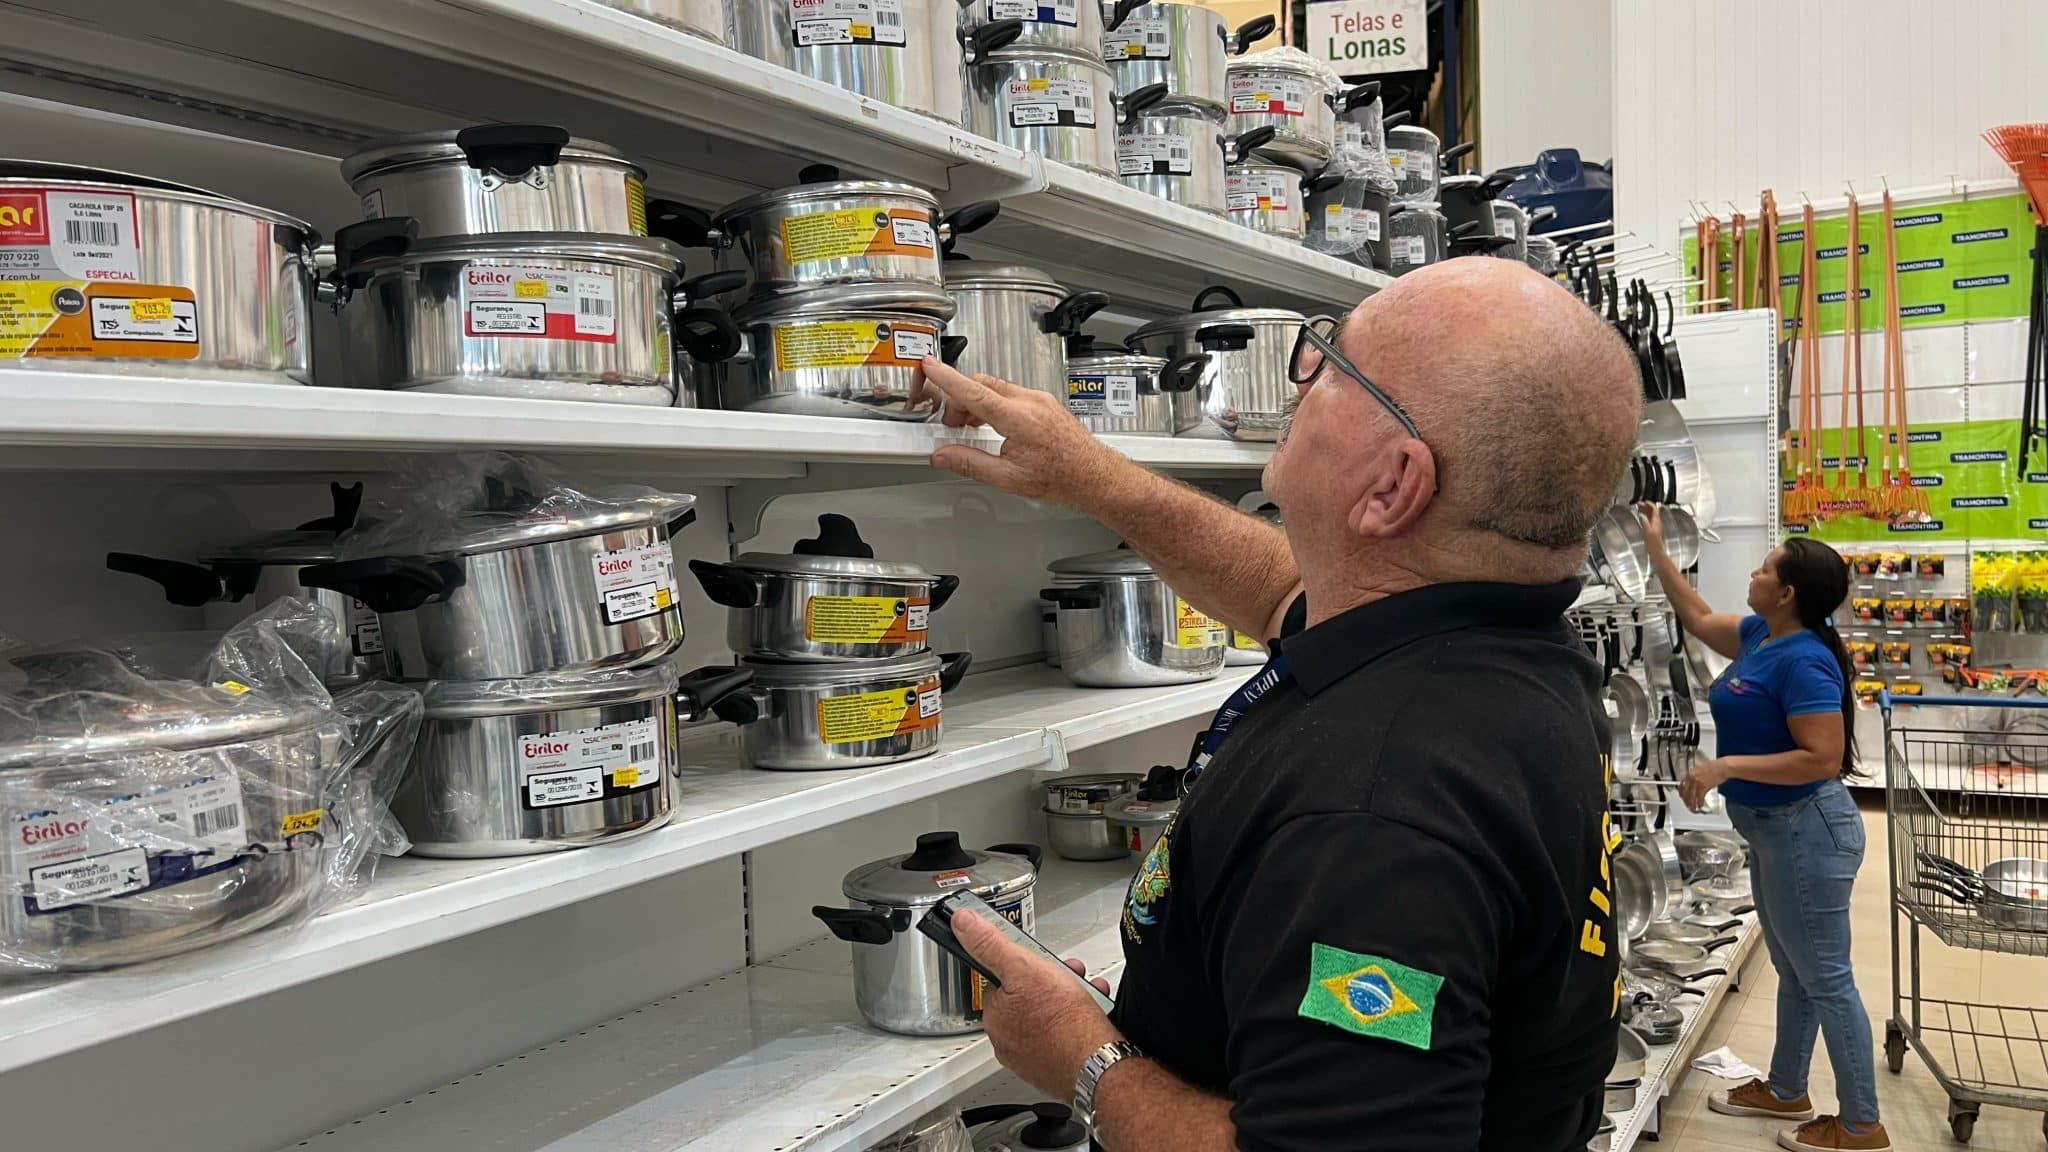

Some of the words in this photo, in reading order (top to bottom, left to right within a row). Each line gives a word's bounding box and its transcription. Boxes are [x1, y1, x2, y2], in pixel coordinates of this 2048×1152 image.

[1330, 11, 1385, 34] Telas
[1391, 13, 1403, 29] e
[1329, 36, 1406, 61] Lonas
[1955, 230, 2005, 242] TRAMONTINA
[16, 253, 40, 261] 9220
[86, 269, 136, 281] ESPECIAL
[468, 270, 512, 285] Eirilar
[1957, 276, 2006, 288] TRAMONTINA
[99, 302, 131, 311] Segura
[1954, 453, 2005, 461] TRAMONTINA
[1955, 499, 2005, 507] TRAMONTINA
[1892, 522, 1940, 531] TRAMONTINA
[598, 559, 633, 576] Eirilar
[524, 742, 570, 759] Eirilar
[22, 819, 90, 846] Eirilar
